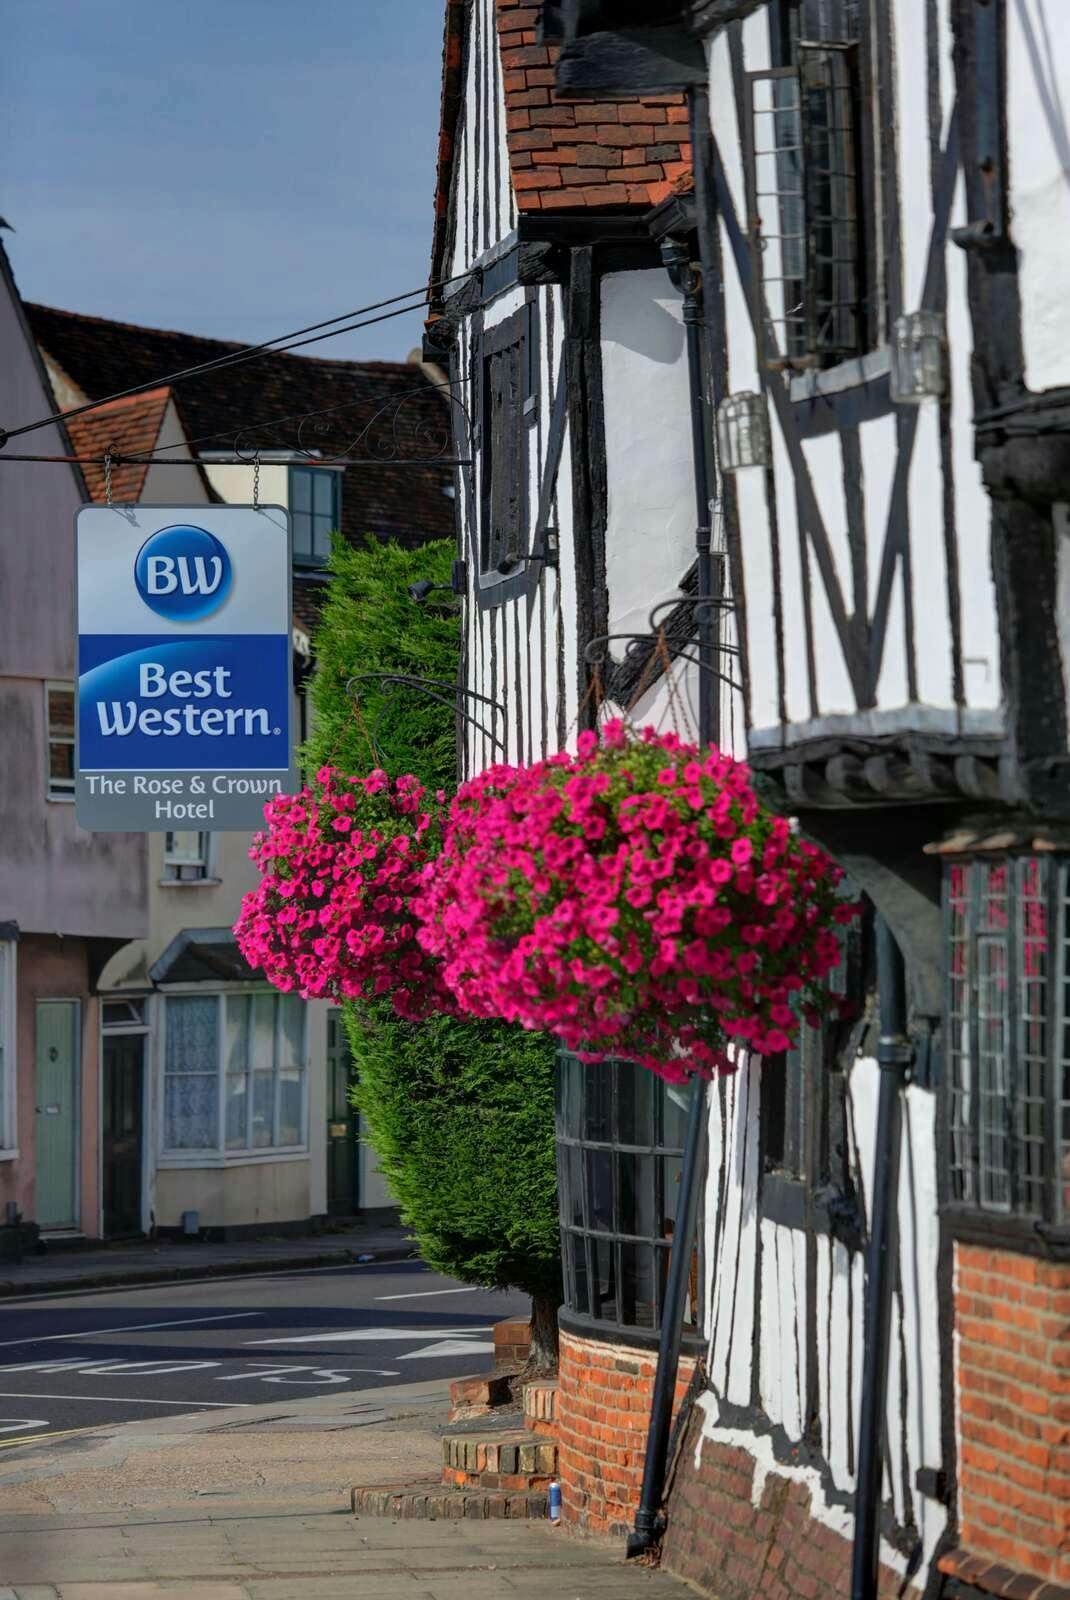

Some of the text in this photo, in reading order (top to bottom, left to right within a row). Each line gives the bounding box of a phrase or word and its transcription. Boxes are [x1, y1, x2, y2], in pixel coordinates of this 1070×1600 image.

[146, 556, 222, 595] BW
[139, 663, 232, 698] Best
[85, 775, 282, 794] The Rose & Crown
[155, 799, 215, 819] Hotel
